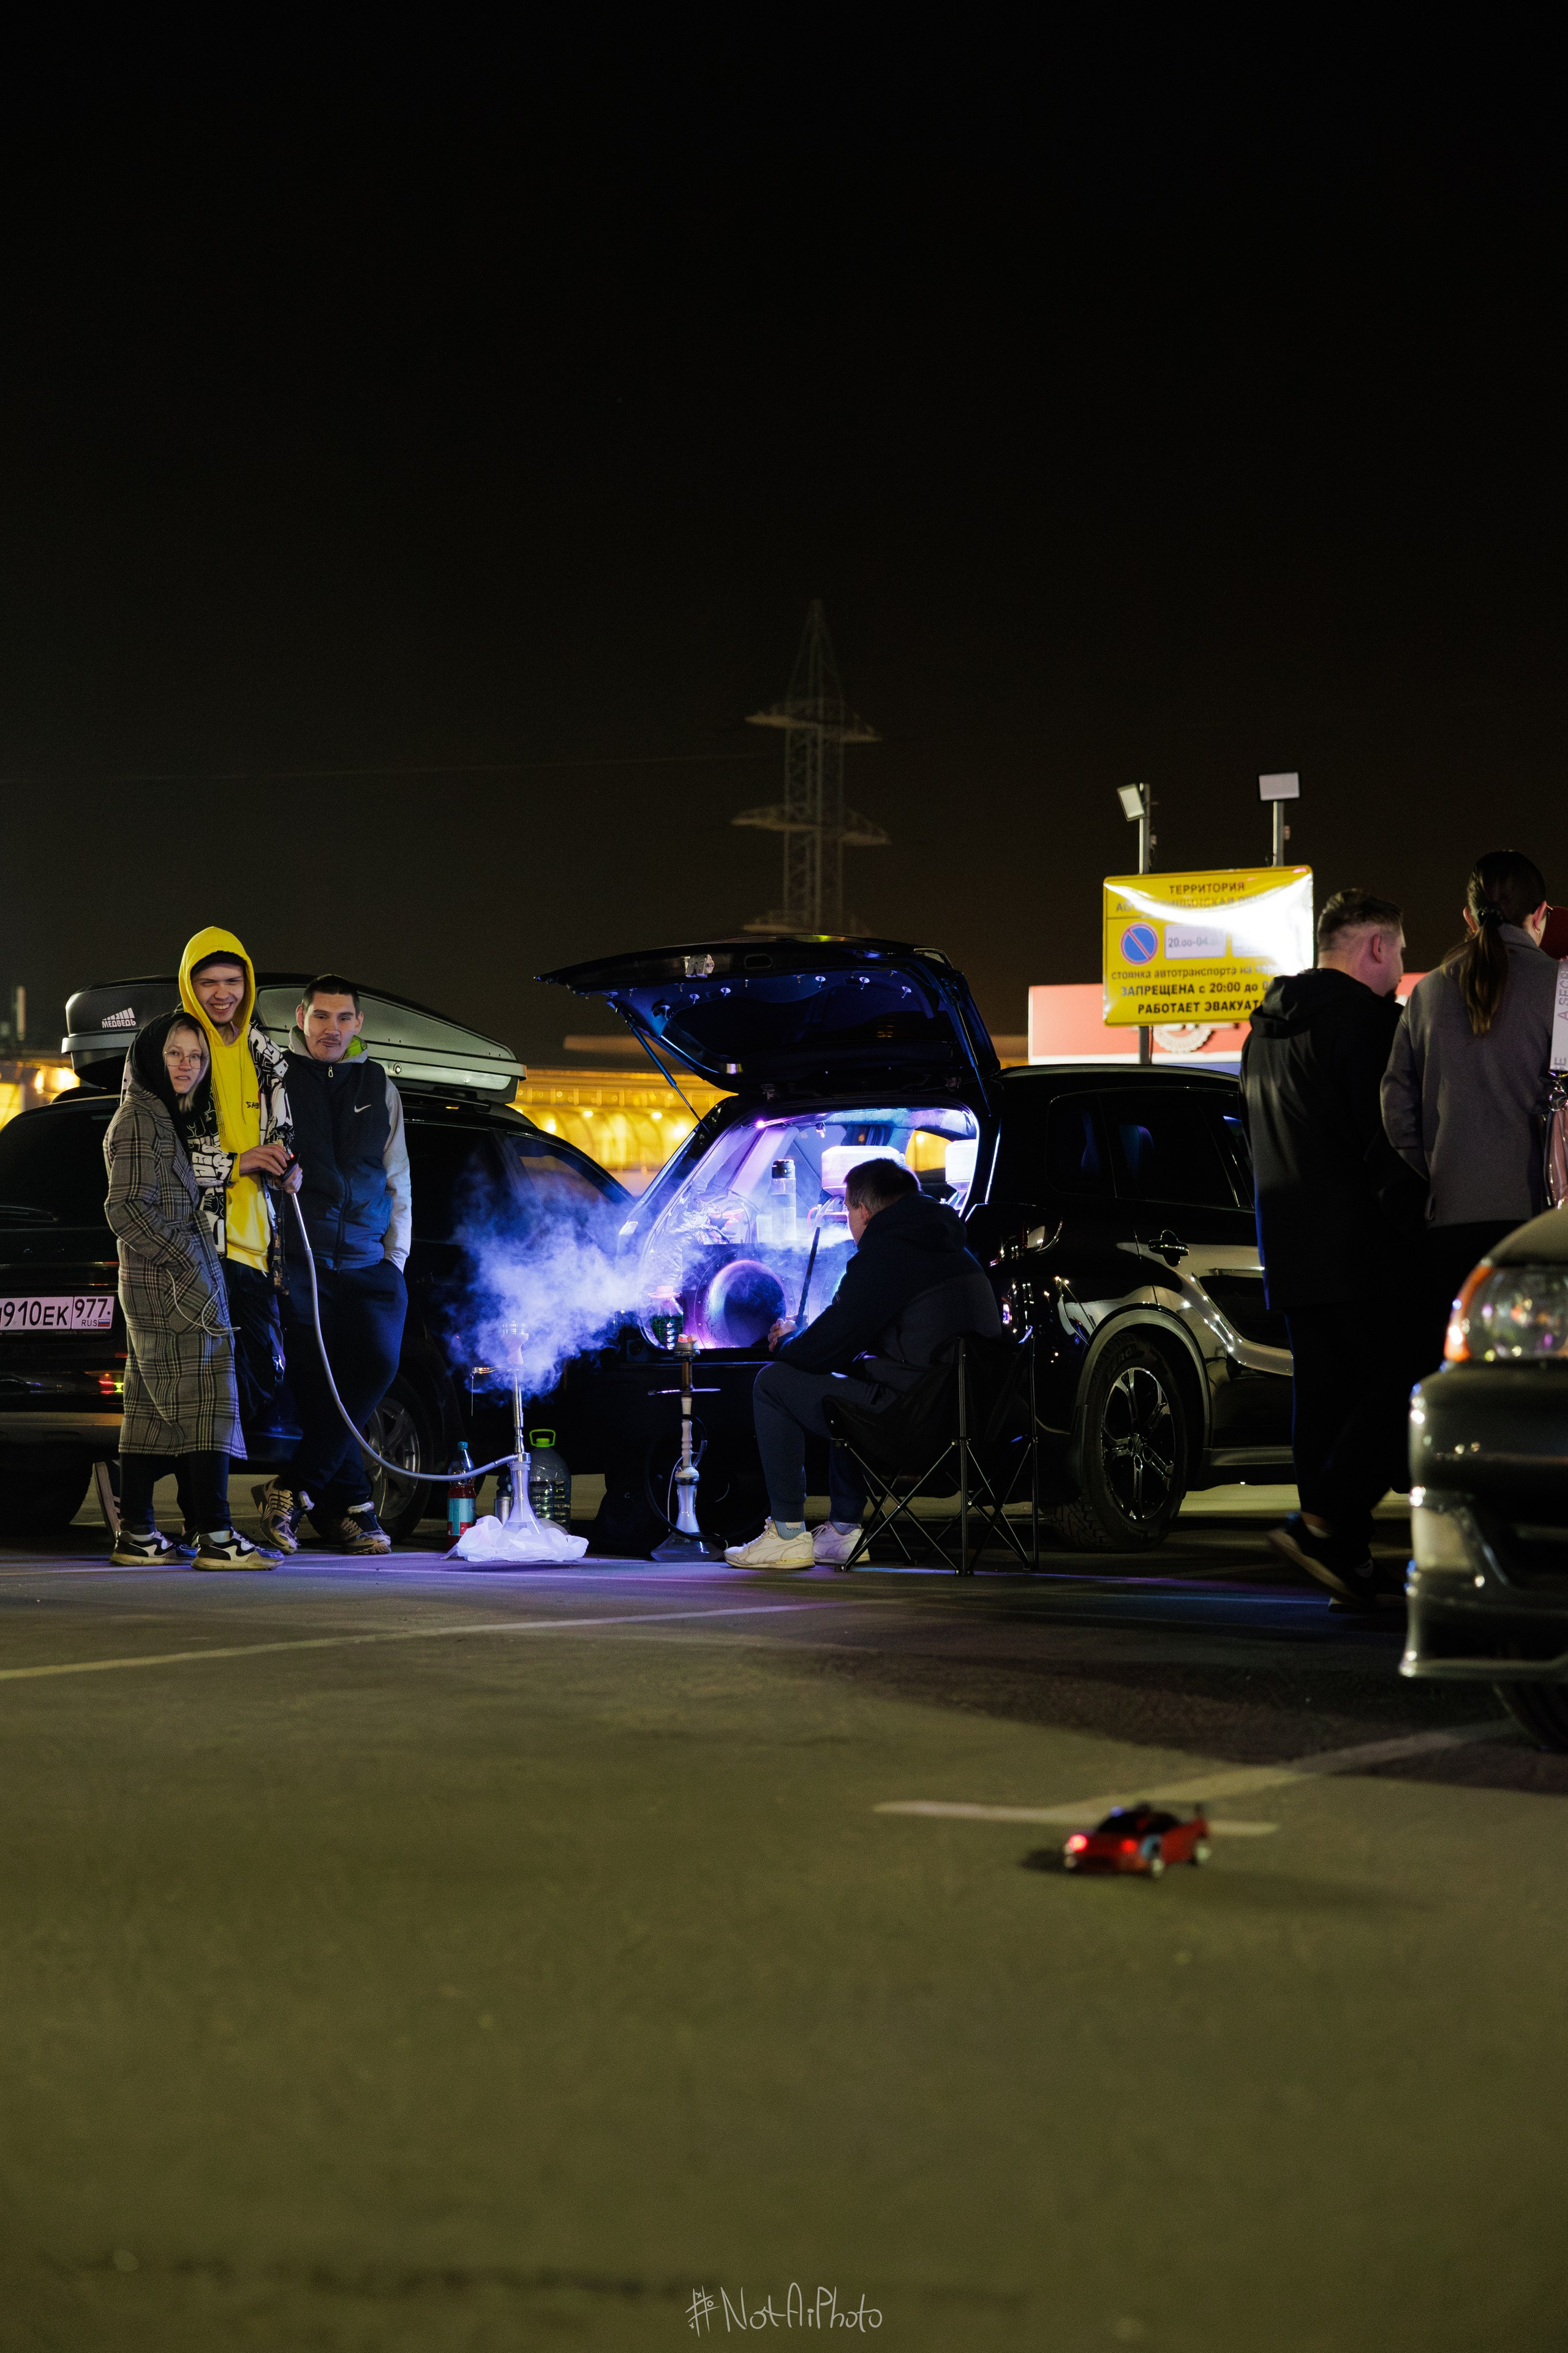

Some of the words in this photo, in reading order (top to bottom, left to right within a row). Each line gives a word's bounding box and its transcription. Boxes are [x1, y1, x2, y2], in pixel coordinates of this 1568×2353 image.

[1169, 881, 1245, 895] ТЕРРИТОРИЯ
[1111, 970, 1151, 980] стоянка
[1154, 966, 1237, 979] автотранспорта
[1240, 966, 1252, 975] на
[1120, 981, 1194, 997] ЗАПРЕЩЕНА
[1199, 984, 1205, 993] с
[1209, 981, 1241, 994] 20:00
[1244, 983, 1258, 994] до
[1137, 1002, 1200, 1015] РАБОТАЕТ
[1204, 1000, 1261, 1013] ЭВАКУАТ
[102, 1019, 136, 1029] МЕДВЕДЬ
[0, 1301, 69, 1327] 910EK
[74, 1298, 108, 1318] 977
